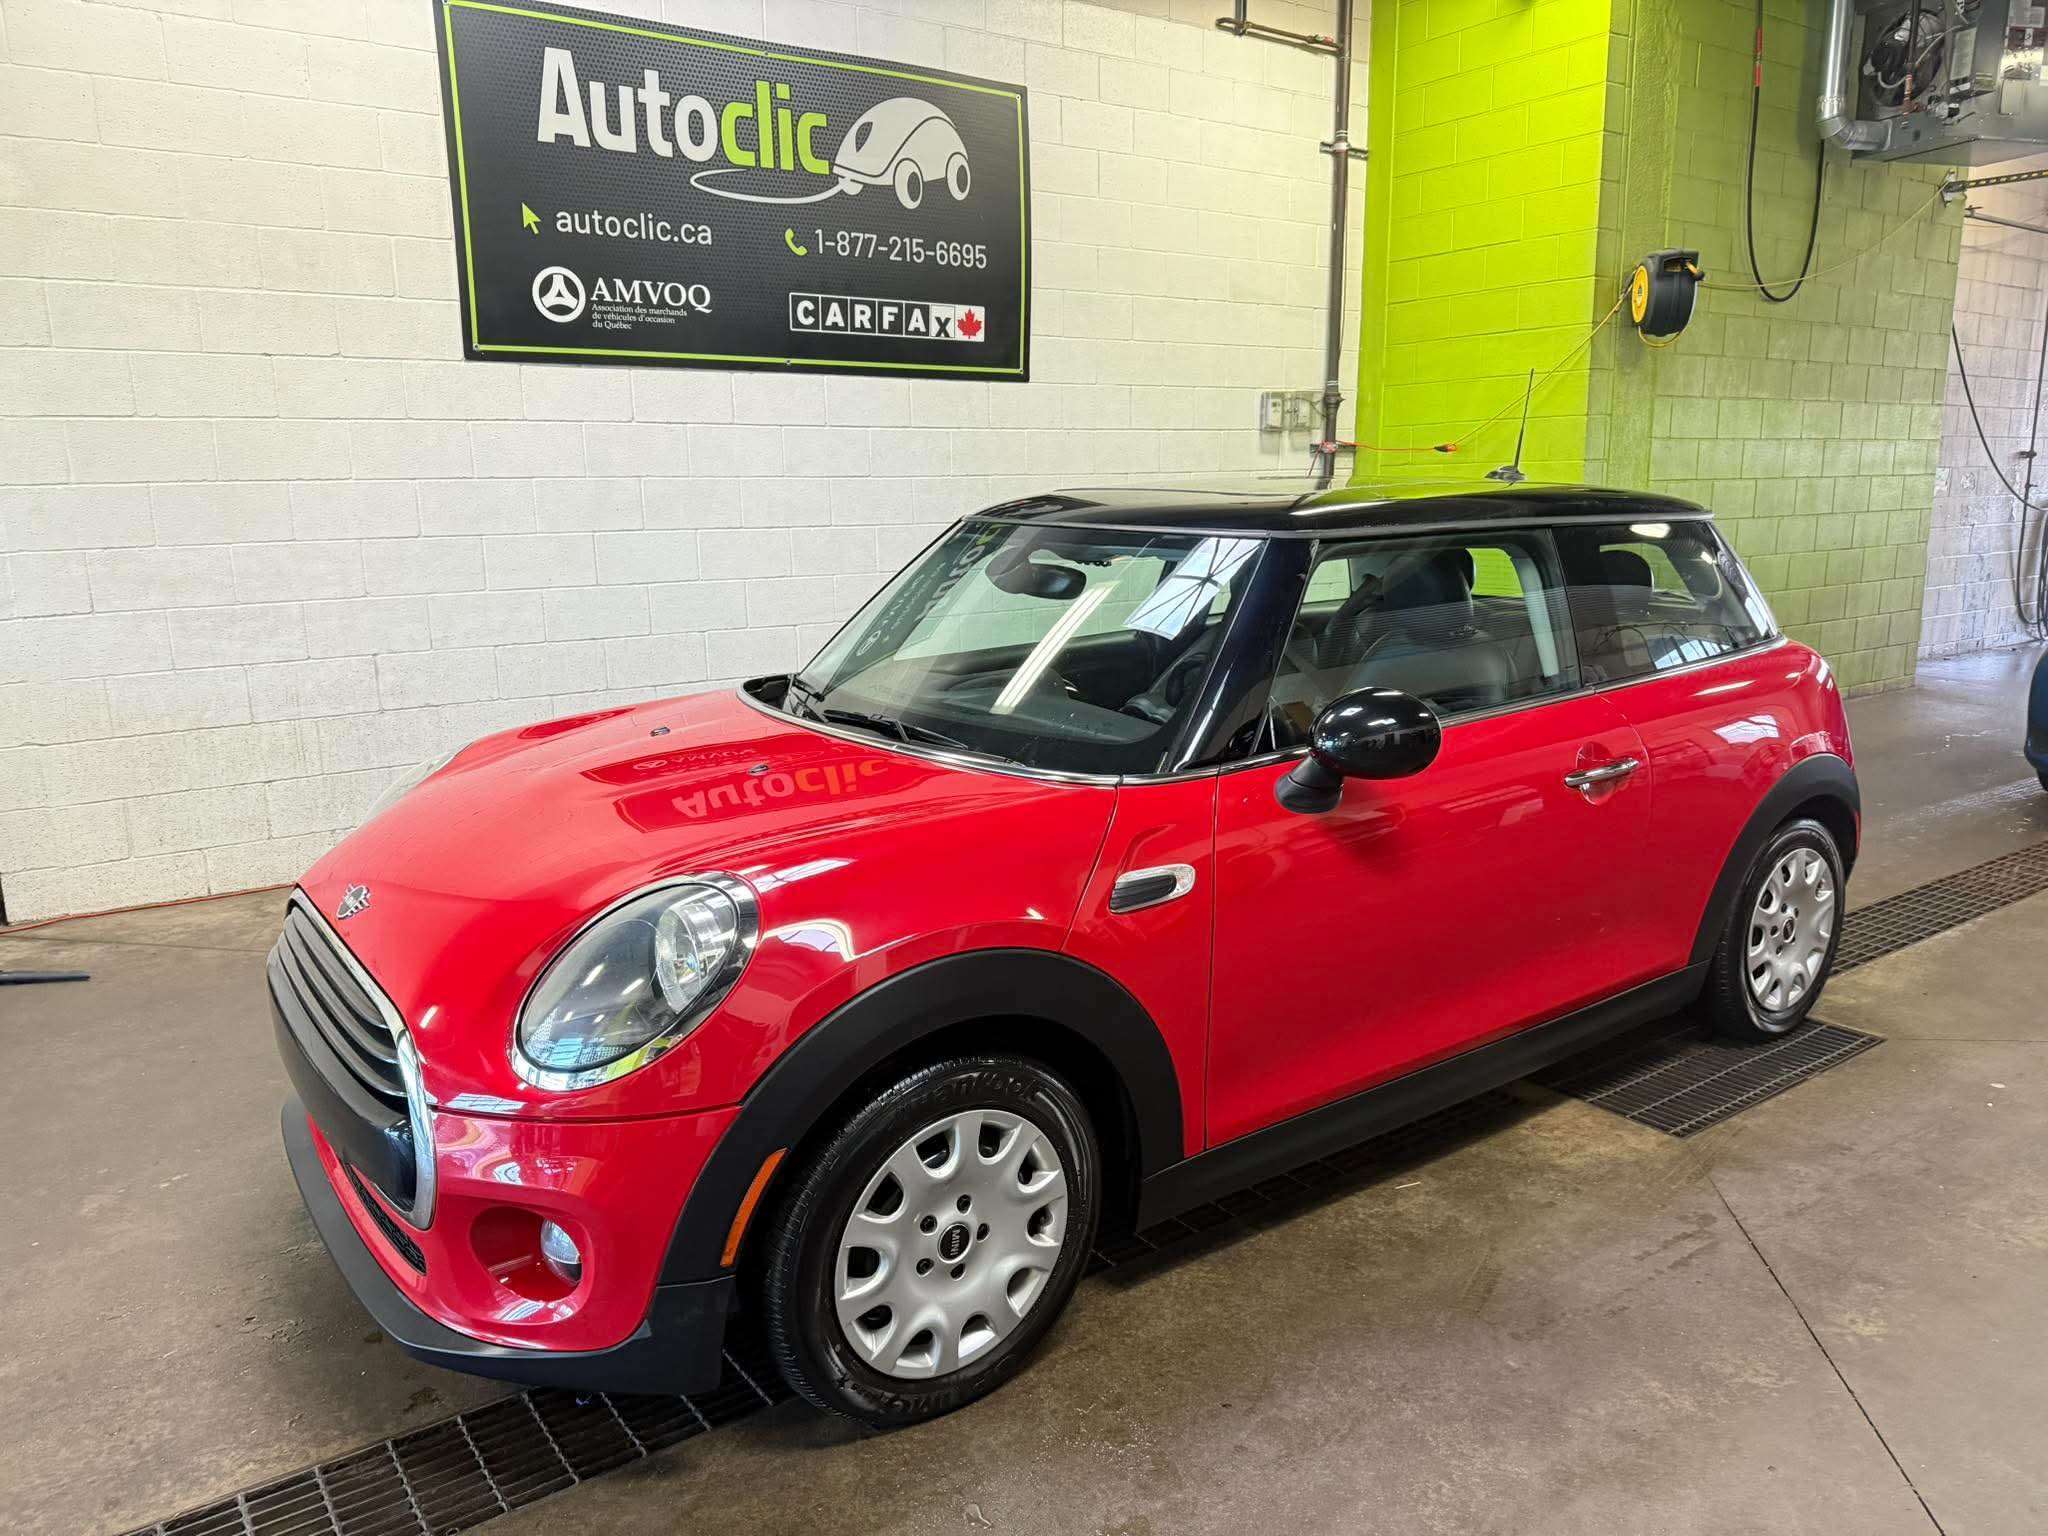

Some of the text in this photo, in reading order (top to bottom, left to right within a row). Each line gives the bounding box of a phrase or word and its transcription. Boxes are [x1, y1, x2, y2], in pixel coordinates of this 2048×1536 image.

[537, 46, 830, 176] Autoclic
[555, 209, 713, 246] autoclic.ca
[814, 228, 988, 270] 1-877-215-6695
[590, 277, 713, 314] AMVOQ
[592, 303, 688, 317] Association des marchands
[592, 312, 602, 320] de
[603, 312, 637, 322] véhicules
[592, 320, 632, 330] du Québec
[795, 299, 952, 338] CARFAX
[950, 1228, 961, 1256] MINI
